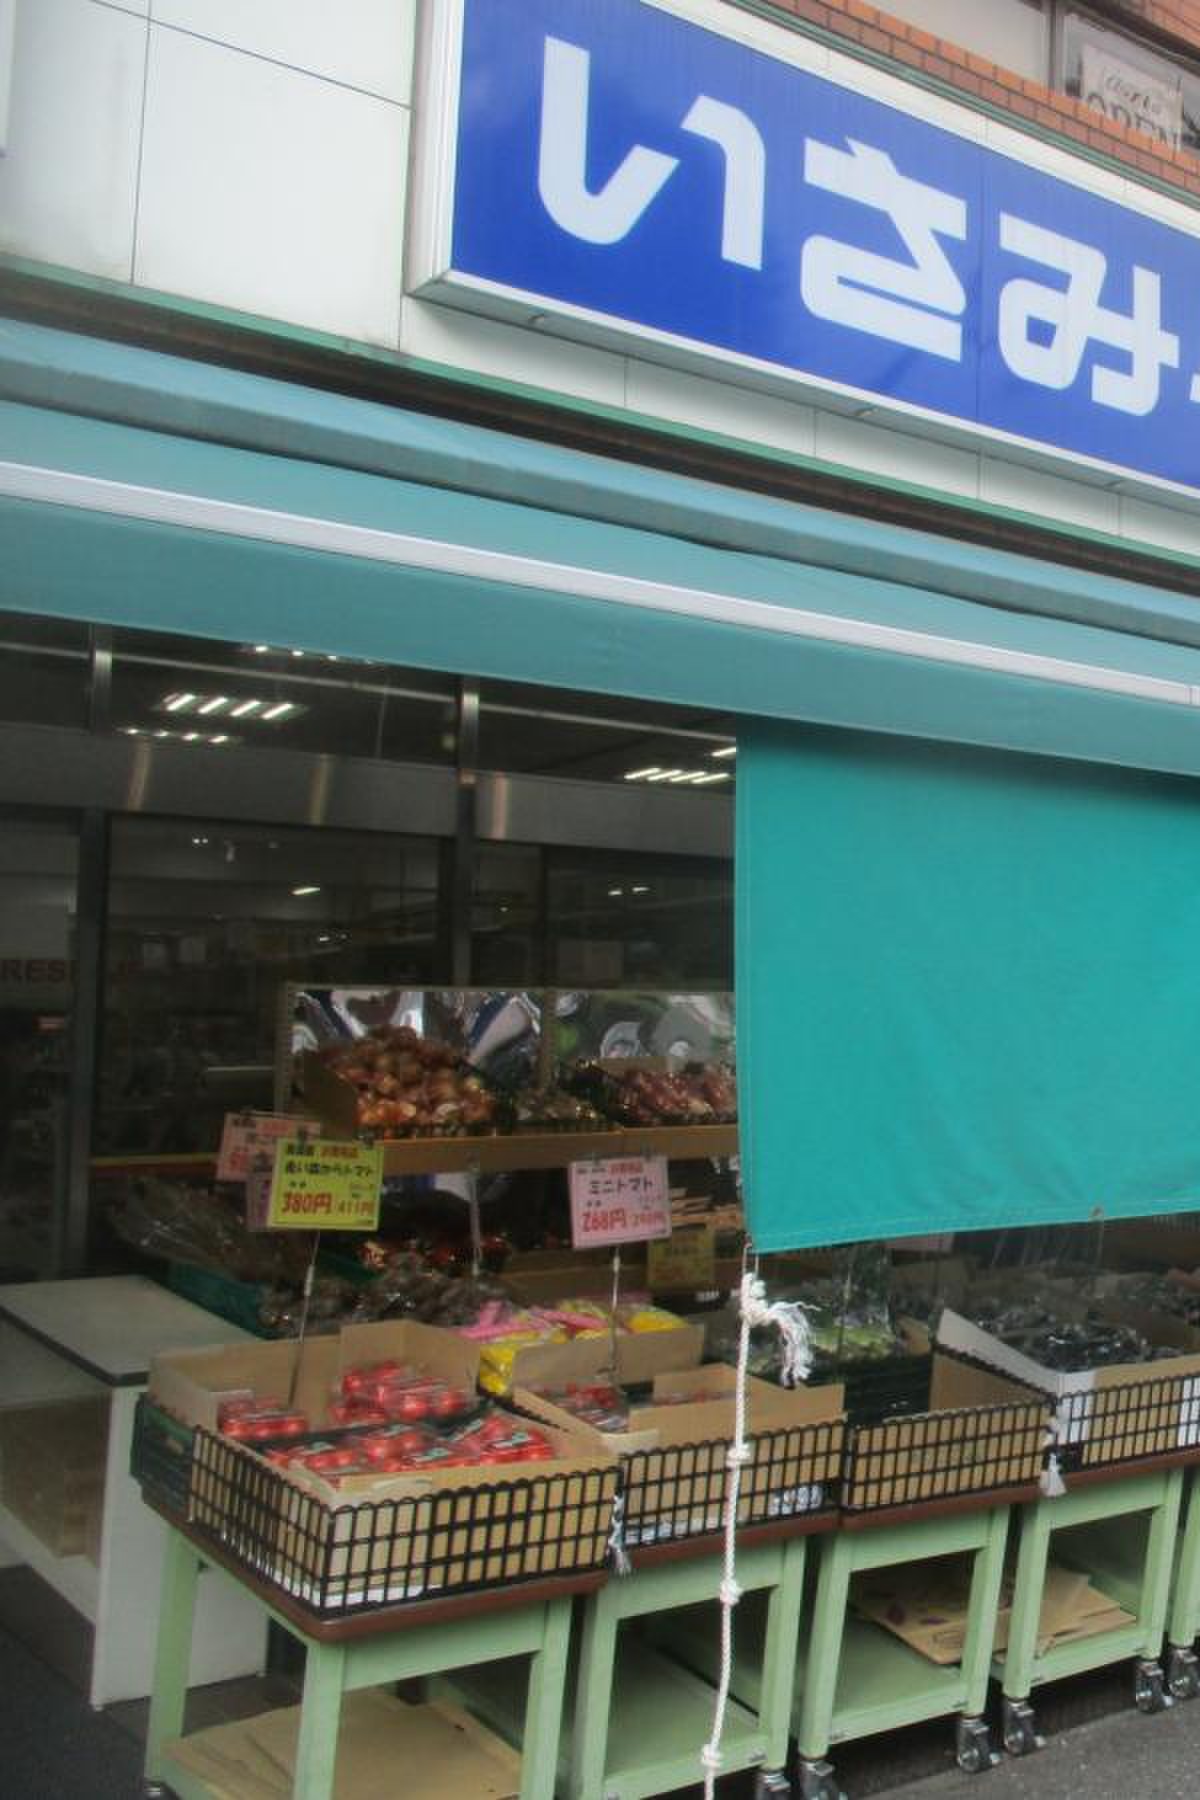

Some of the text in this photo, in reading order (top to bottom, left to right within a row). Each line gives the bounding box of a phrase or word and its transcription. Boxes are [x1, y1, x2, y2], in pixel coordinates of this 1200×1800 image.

[588, 1175, 653, 1195] ミニトマト
[281, 1191, 333, 1215] 380円
